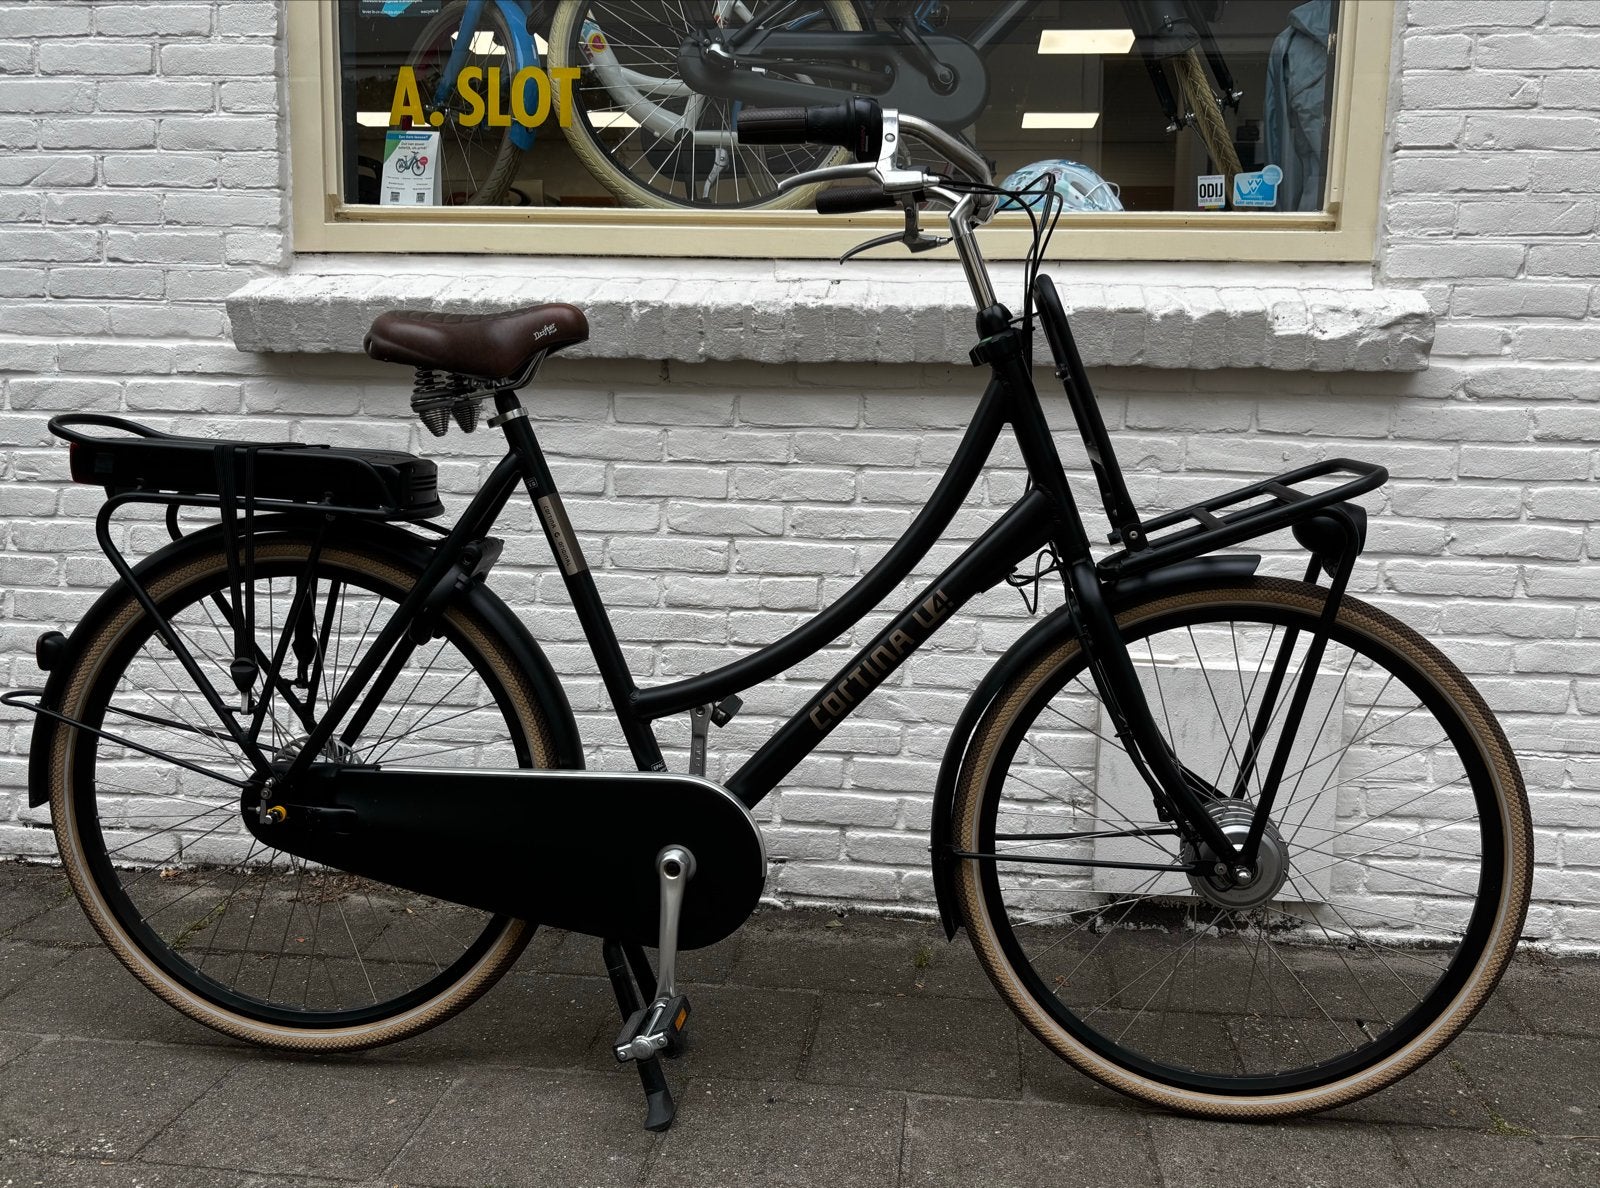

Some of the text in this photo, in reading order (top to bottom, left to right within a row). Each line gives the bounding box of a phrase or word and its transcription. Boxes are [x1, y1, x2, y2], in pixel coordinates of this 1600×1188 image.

[389, 66, 581, 128] A. SLOT
[1199, 183, 1223, 198] ODIJ
[809, 628, 915, 731] CORTINA
